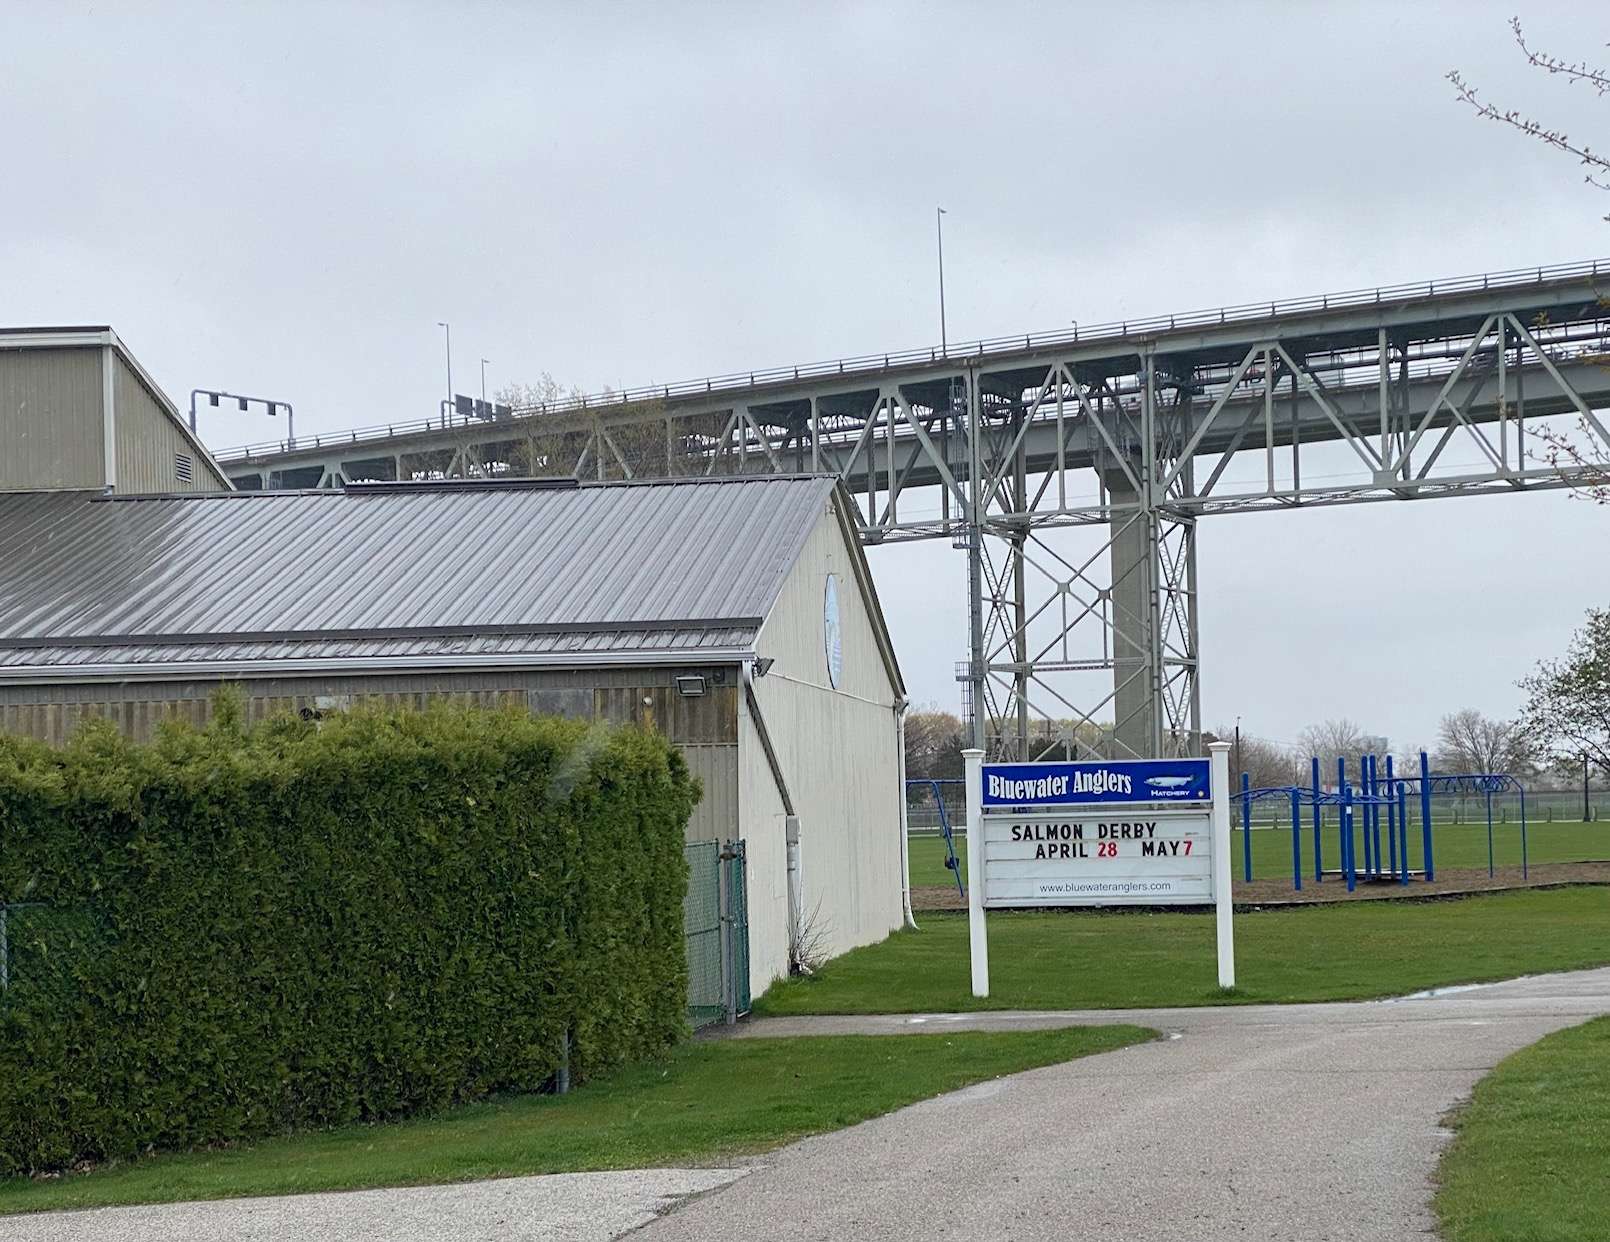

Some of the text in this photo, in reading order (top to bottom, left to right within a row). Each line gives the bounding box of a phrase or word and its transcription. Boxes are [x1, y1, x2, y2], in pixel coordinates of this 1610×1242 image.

[988, 769, 1132, 800] Bluewater Anglers
[1011, 822, 1157, 841] SALMON DERBY
[1035, 840, 1193, 860] APRIL 28 MAY 7
[1039, 880, 1171, 894] www.bluewateranglers.com
